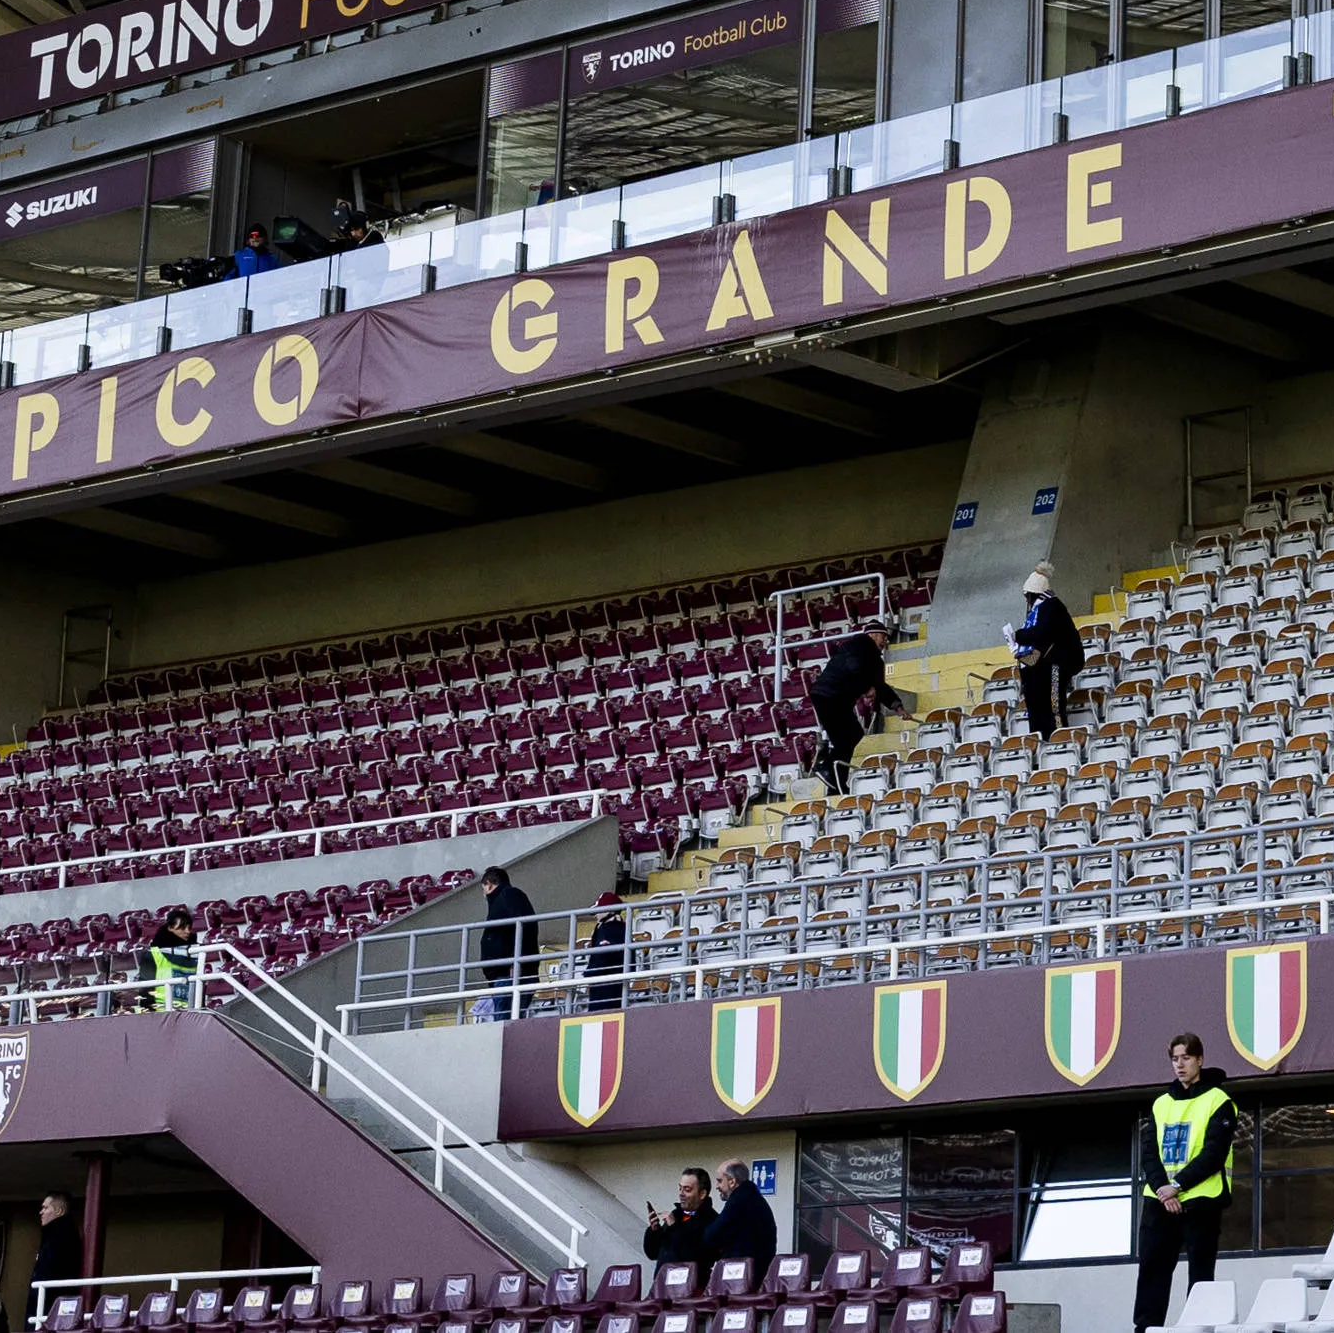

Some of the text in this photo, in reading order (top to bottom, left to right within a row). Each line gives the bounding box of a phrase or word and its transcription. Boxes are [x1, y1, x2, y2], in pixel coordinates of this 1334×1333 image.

[610, 11, 787, 72] TORINO Football Club
[26, 185, 98, 221] SUZUKI
[490, 143, 1122, 373] GRANDE
[1035, 493, 1056, 507] 202
[955, 508, 975, 521] 201
[5, 1064, 22, 1081] FC
